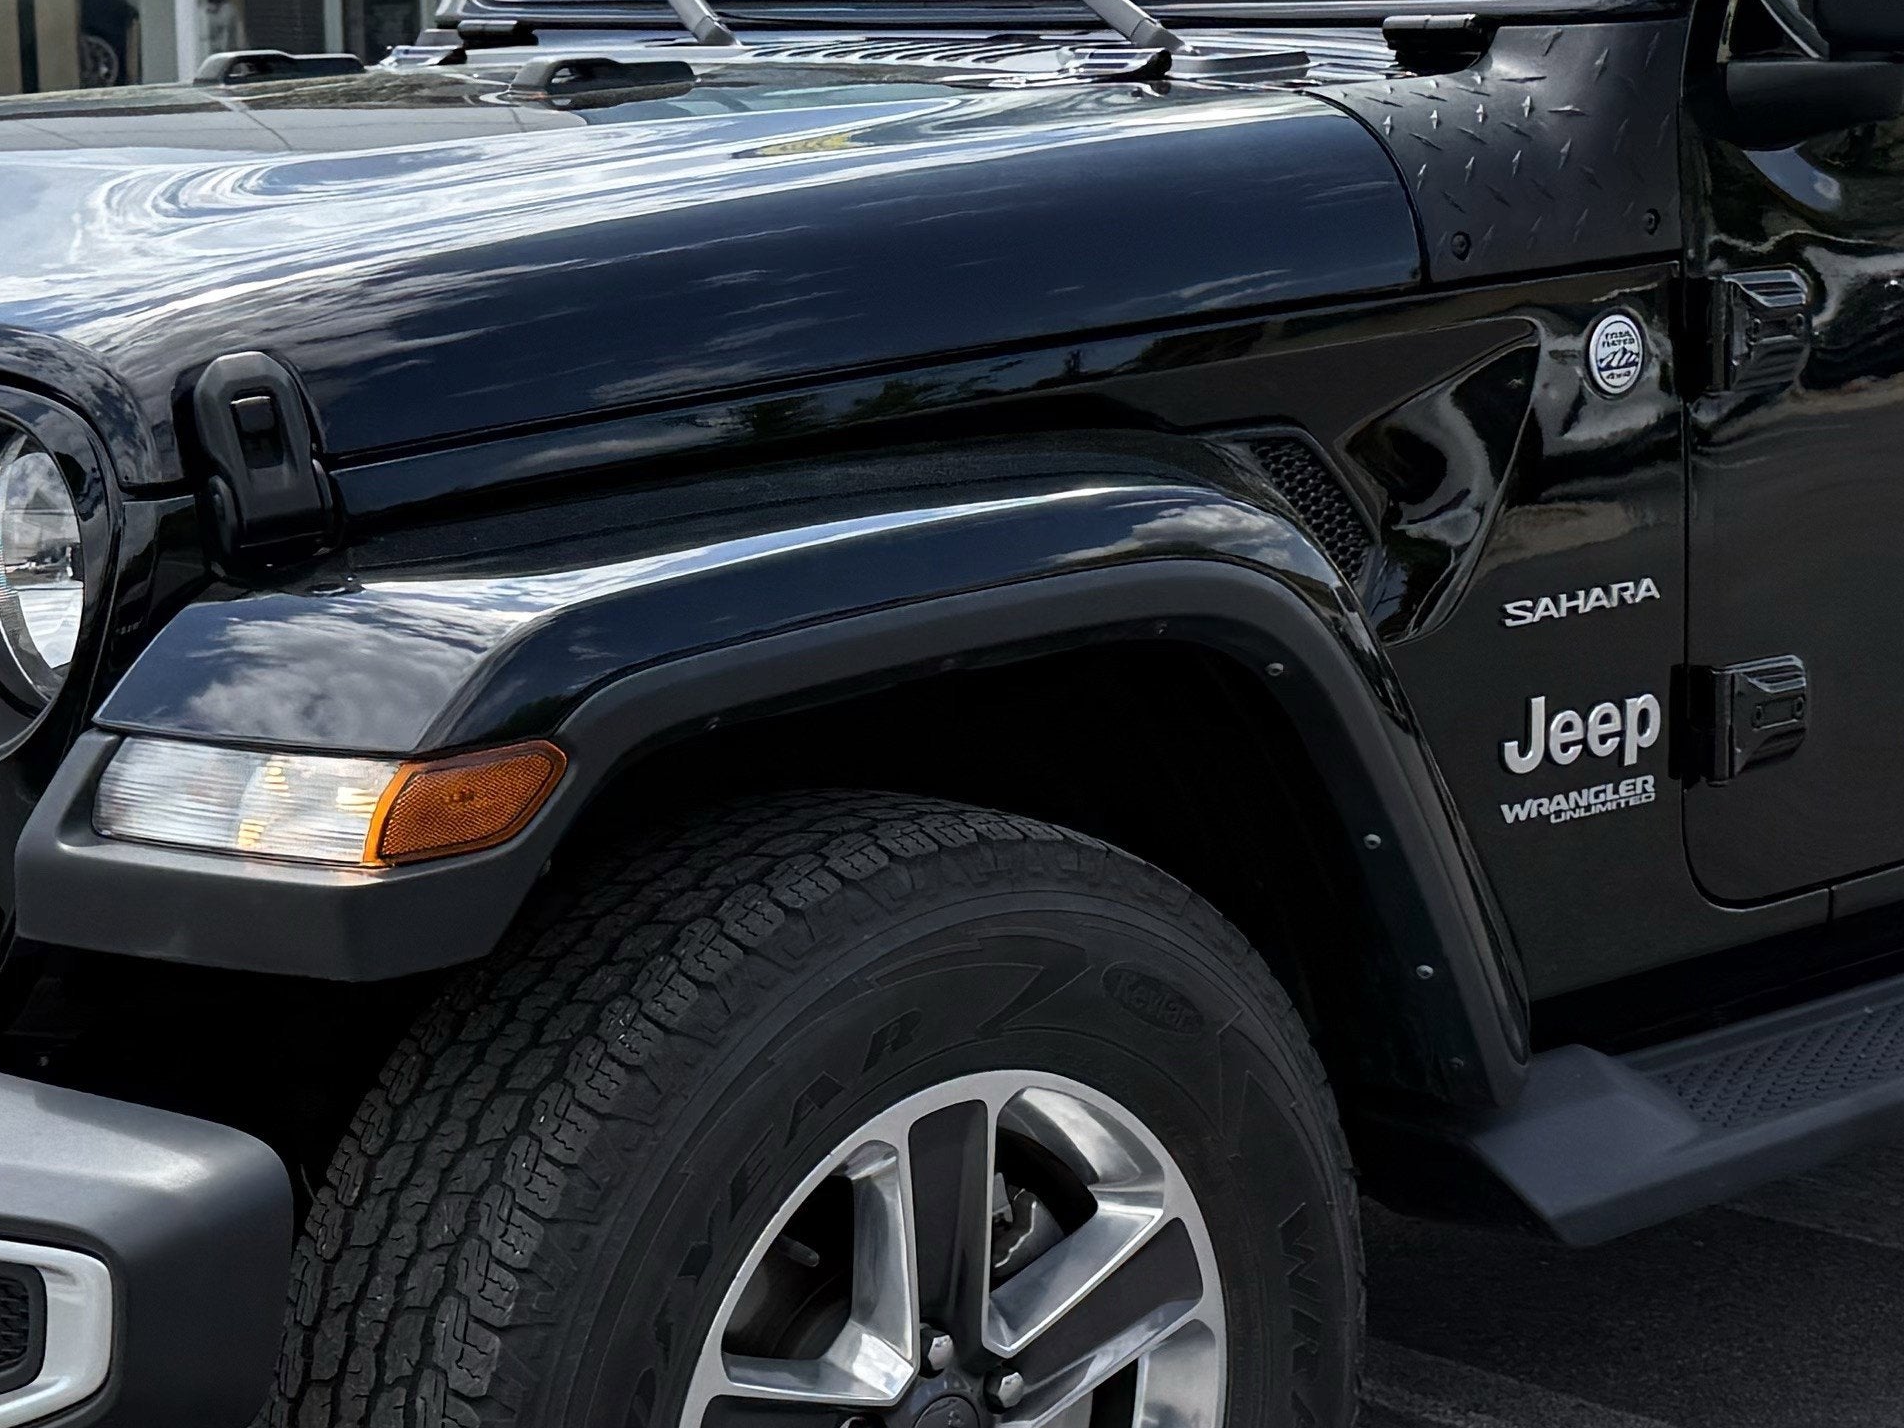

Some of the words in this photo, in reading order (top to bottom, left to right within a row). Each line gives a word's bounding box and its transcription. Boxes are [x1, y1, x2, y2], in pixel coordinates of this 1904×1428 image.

[1504, 577, 1661, 627] SAHARA
[1504, 693, 1661, 774] Jeep
[1500, 774, 1655, 824] WRANGLER
[1549, 792, 1656, 824] UNLIMITED
